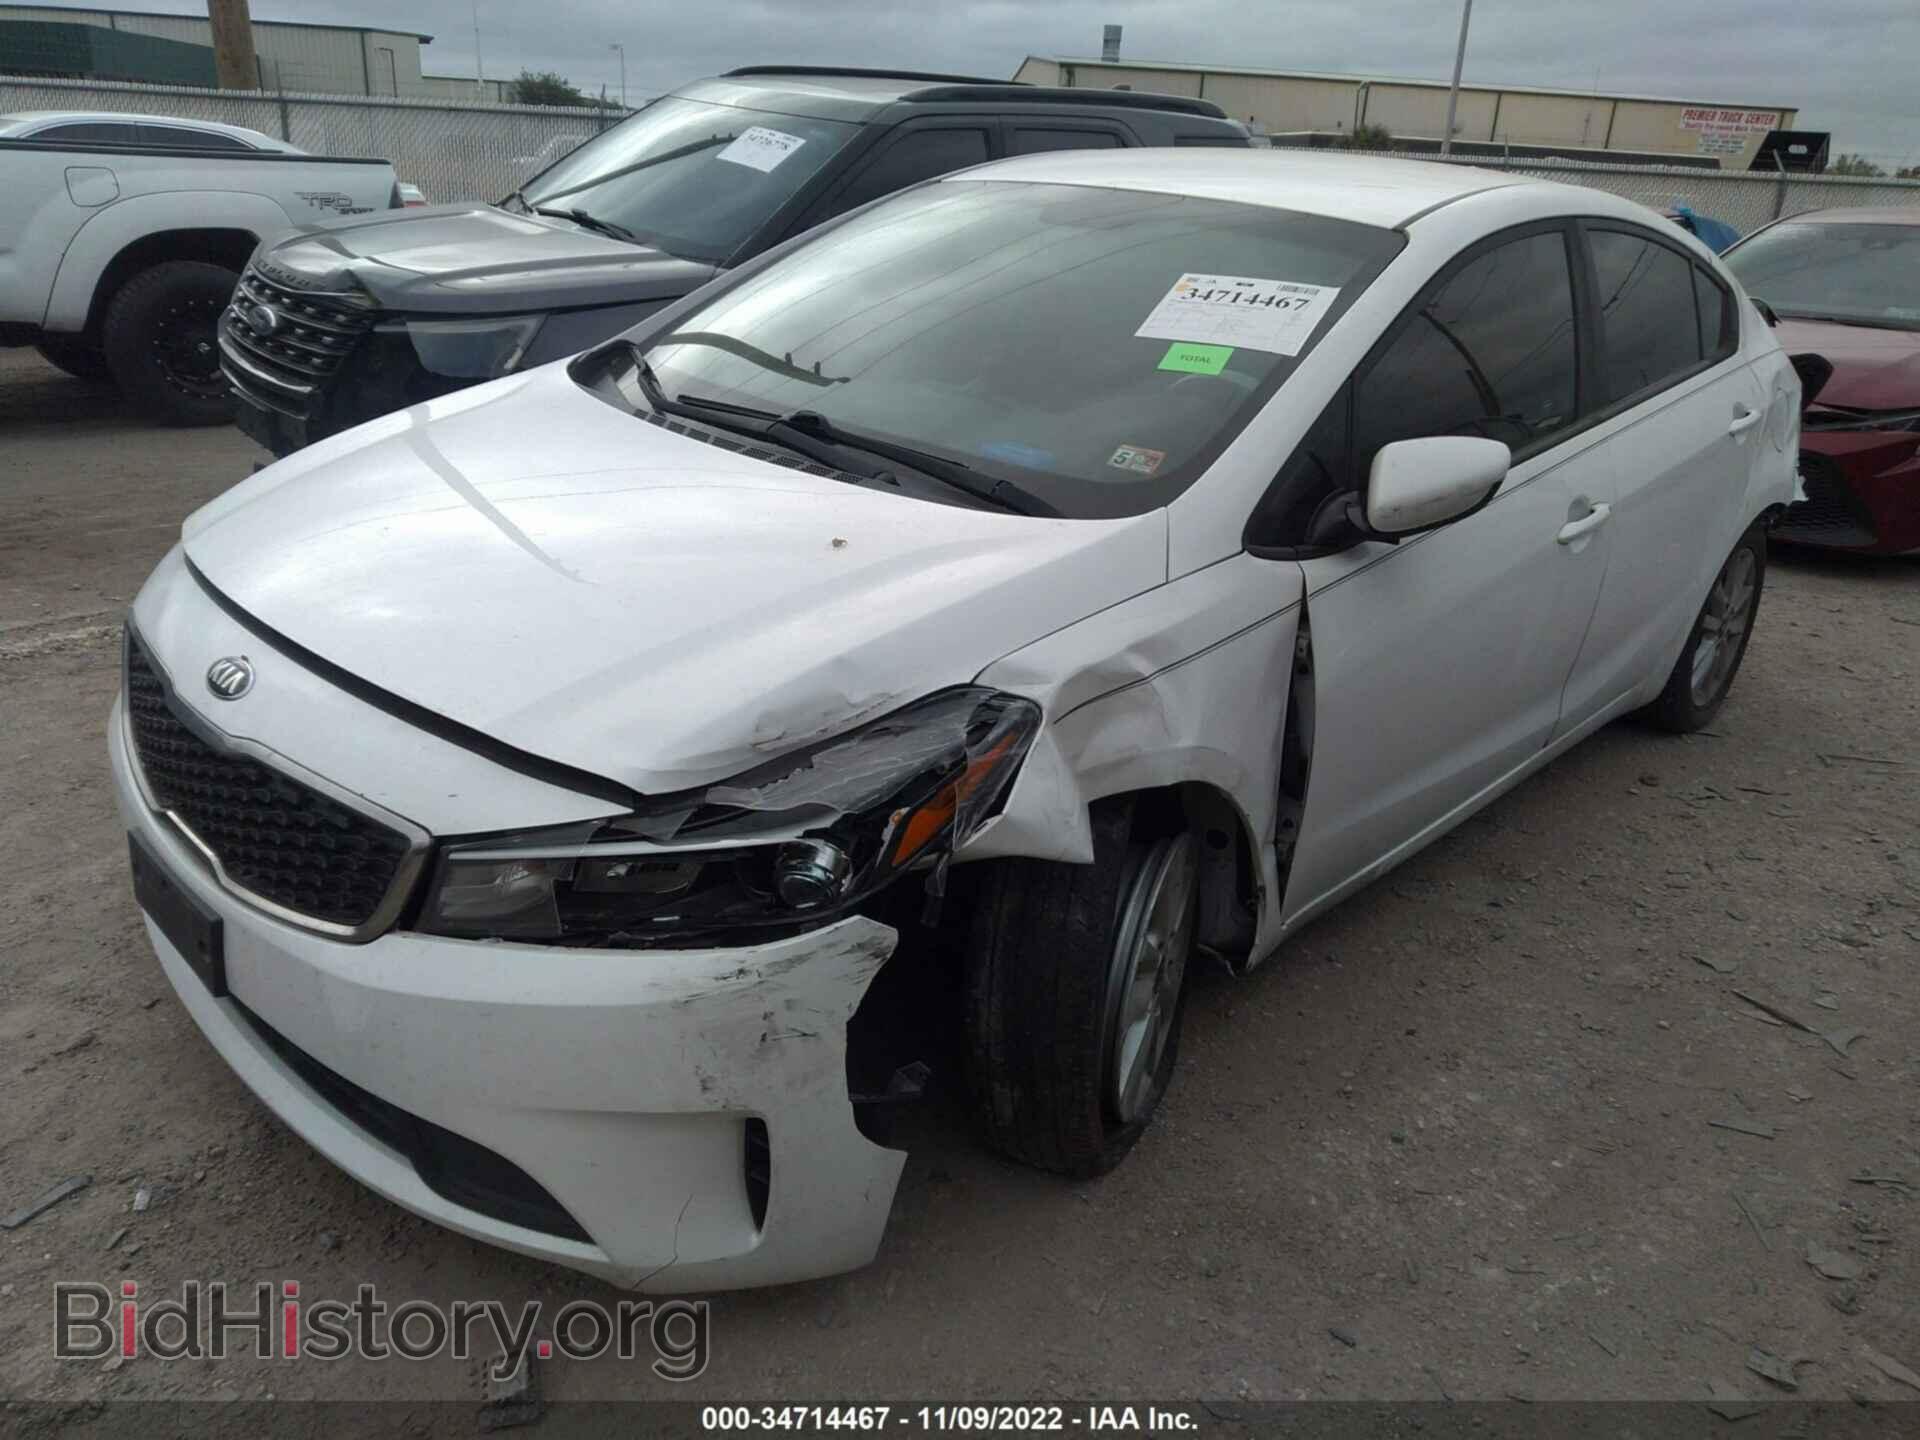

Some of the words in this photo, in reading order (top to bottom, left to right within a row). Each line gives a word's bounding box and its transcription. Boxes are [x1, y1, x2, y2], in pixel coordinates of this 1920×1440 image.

[1683, 109, 1717, 121] PREMIER
[1718, 111, 1744, 123] TRUCK
[1745, 112, 1777, 125] CENTER
[294, 191, 353, 210] TRD
[338, 207, 376, 215] SPORT
[1181, 287, 1310, 311] 34714467
[1113, 451, 1131, 465] 5
